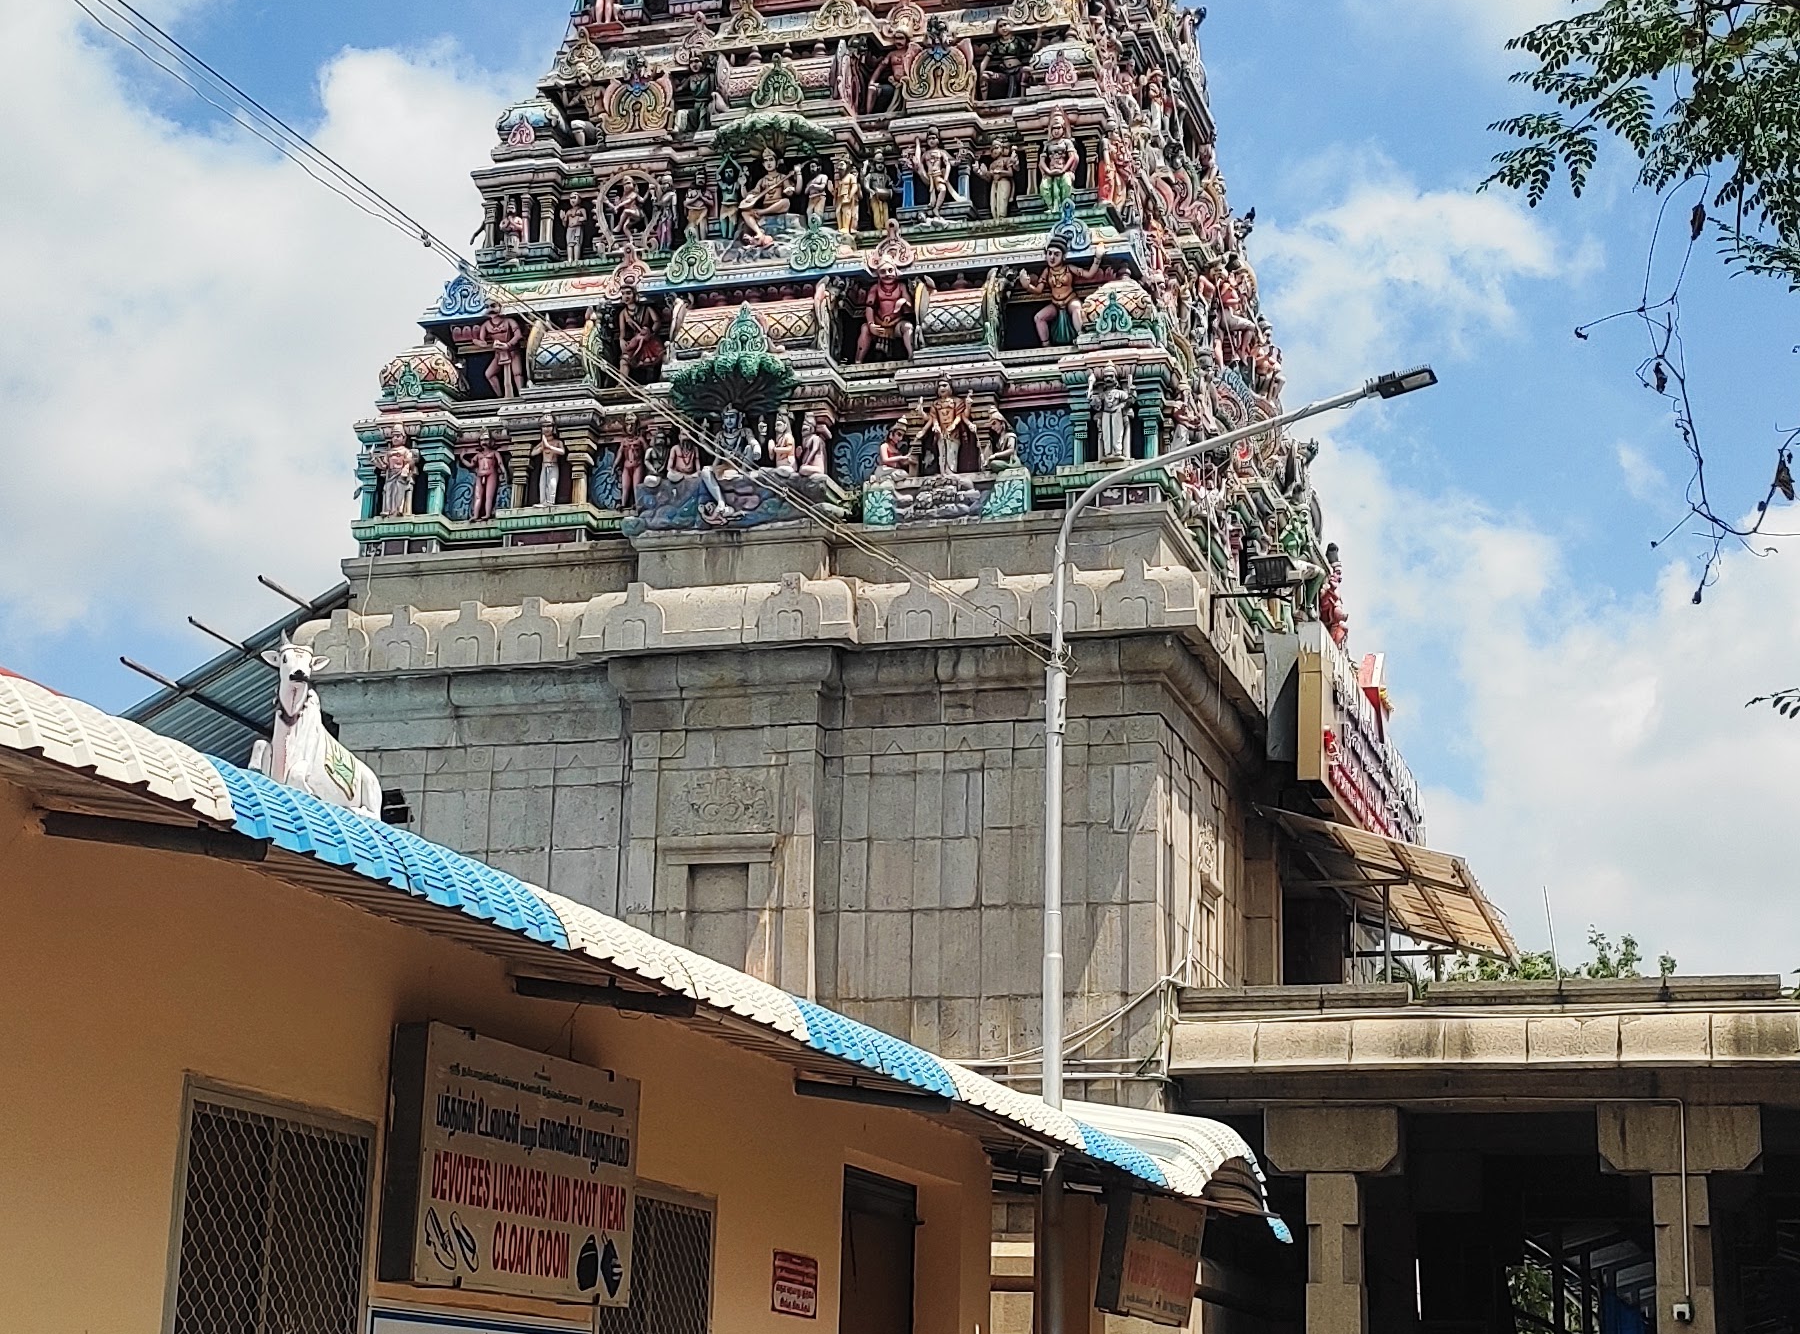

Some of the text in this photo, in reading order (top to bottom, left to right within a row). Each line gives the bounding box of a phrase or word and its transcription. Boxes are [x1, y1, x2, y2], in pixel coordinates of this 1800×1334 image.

[431, 1150, 627, 1232] DEVOTEES LUGGAGES AND FOOT WEAR
[492, 1221, 570, 1279] CLOAK ROOM
